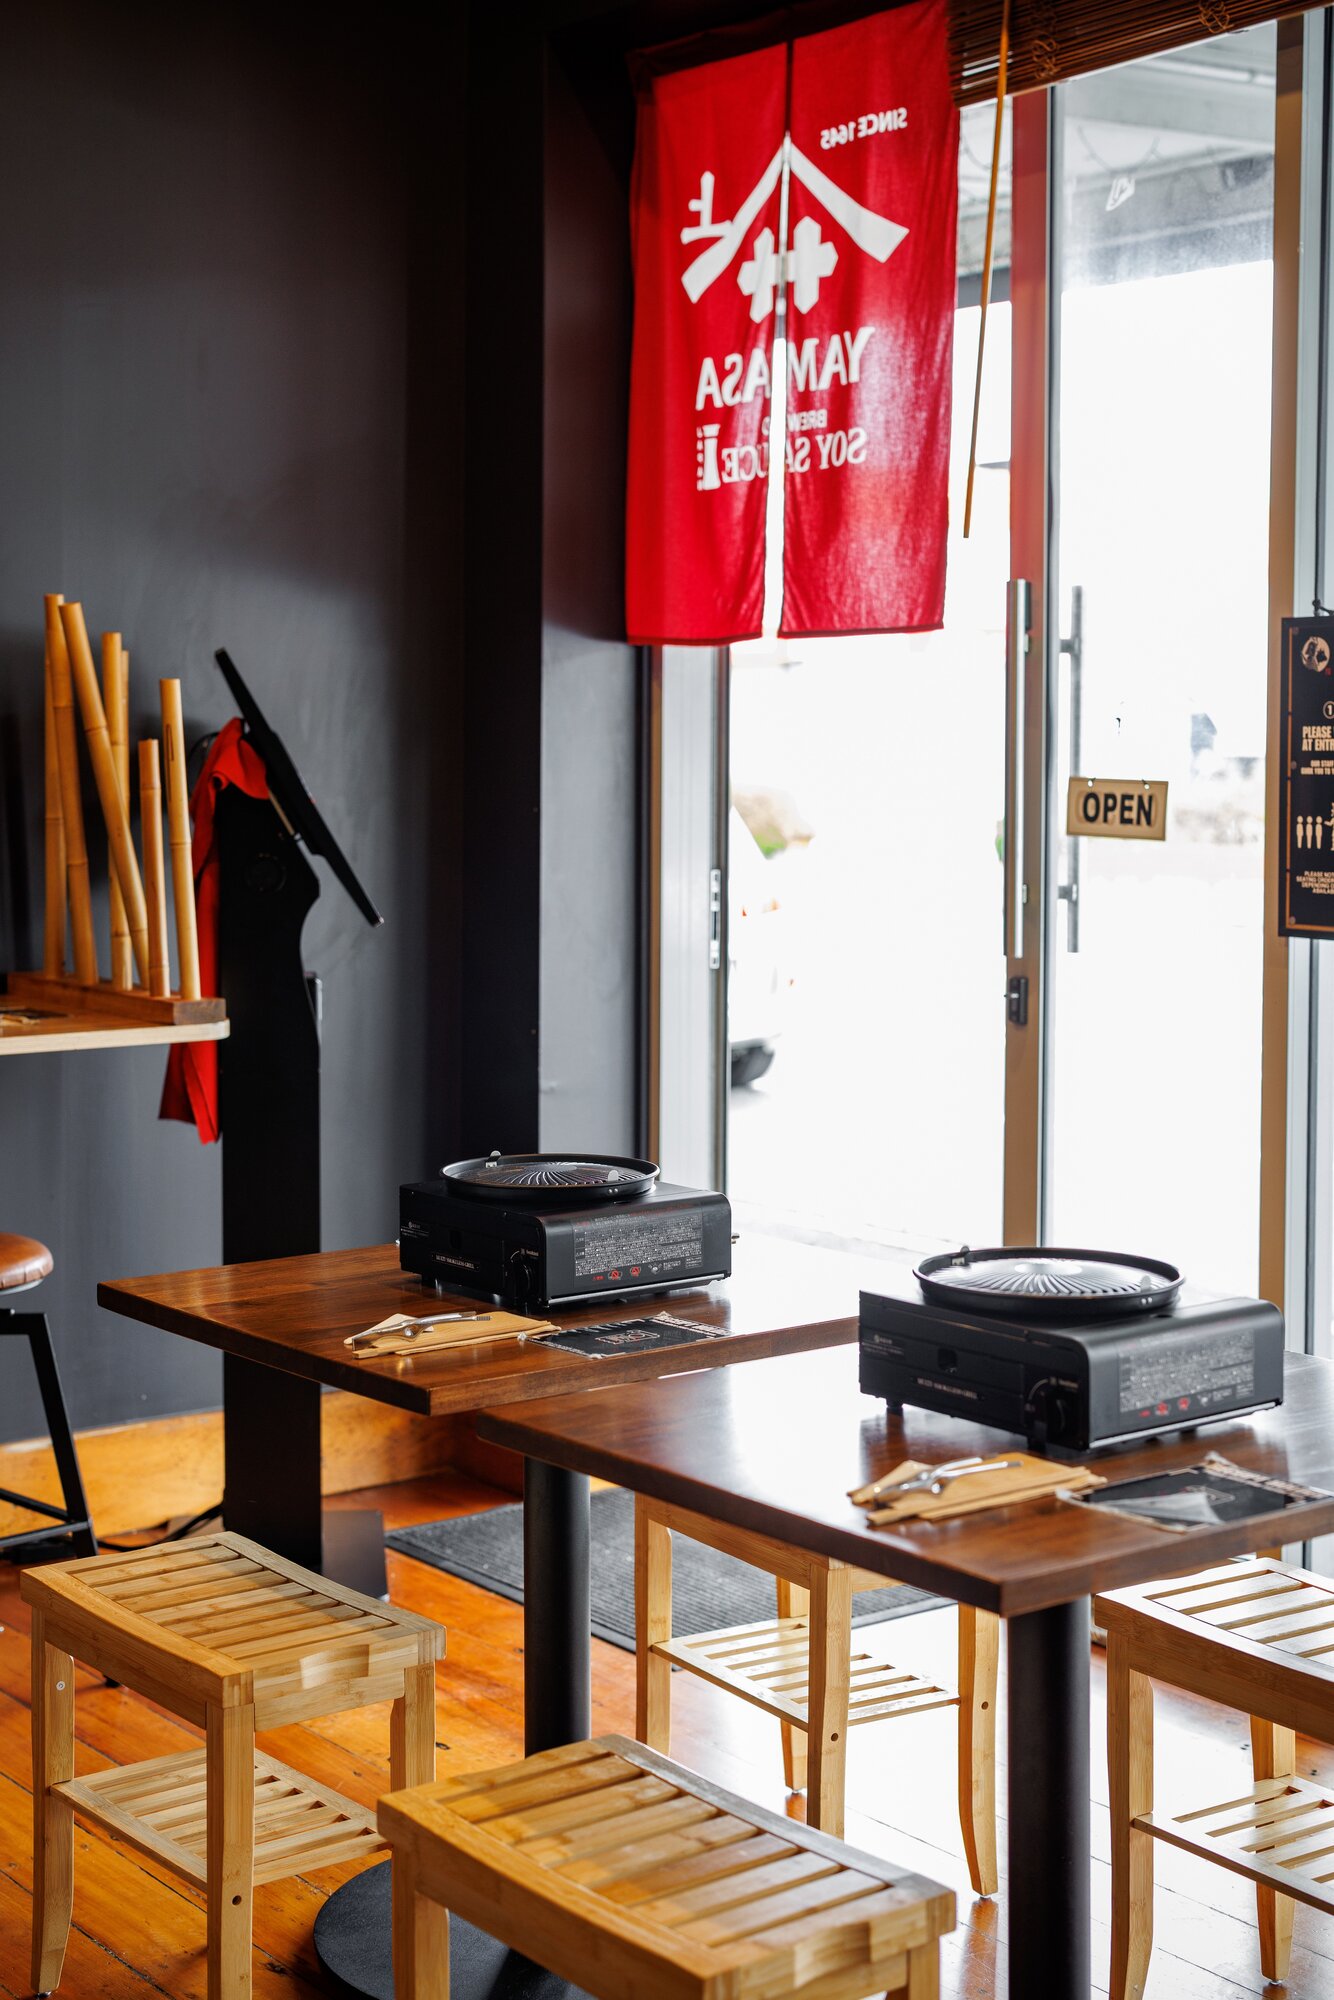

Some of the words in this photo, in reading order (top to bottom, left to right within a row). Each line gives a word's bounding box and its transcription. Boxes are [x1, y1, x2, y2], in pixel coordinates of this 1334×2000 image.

[1302, 725, 1332, 739] PLEASE
[1302, 739, 1313, 752] AT
[1083, 792, 1154, 826] OPEN
[1304, 870, 1323, 878] PLEASE
